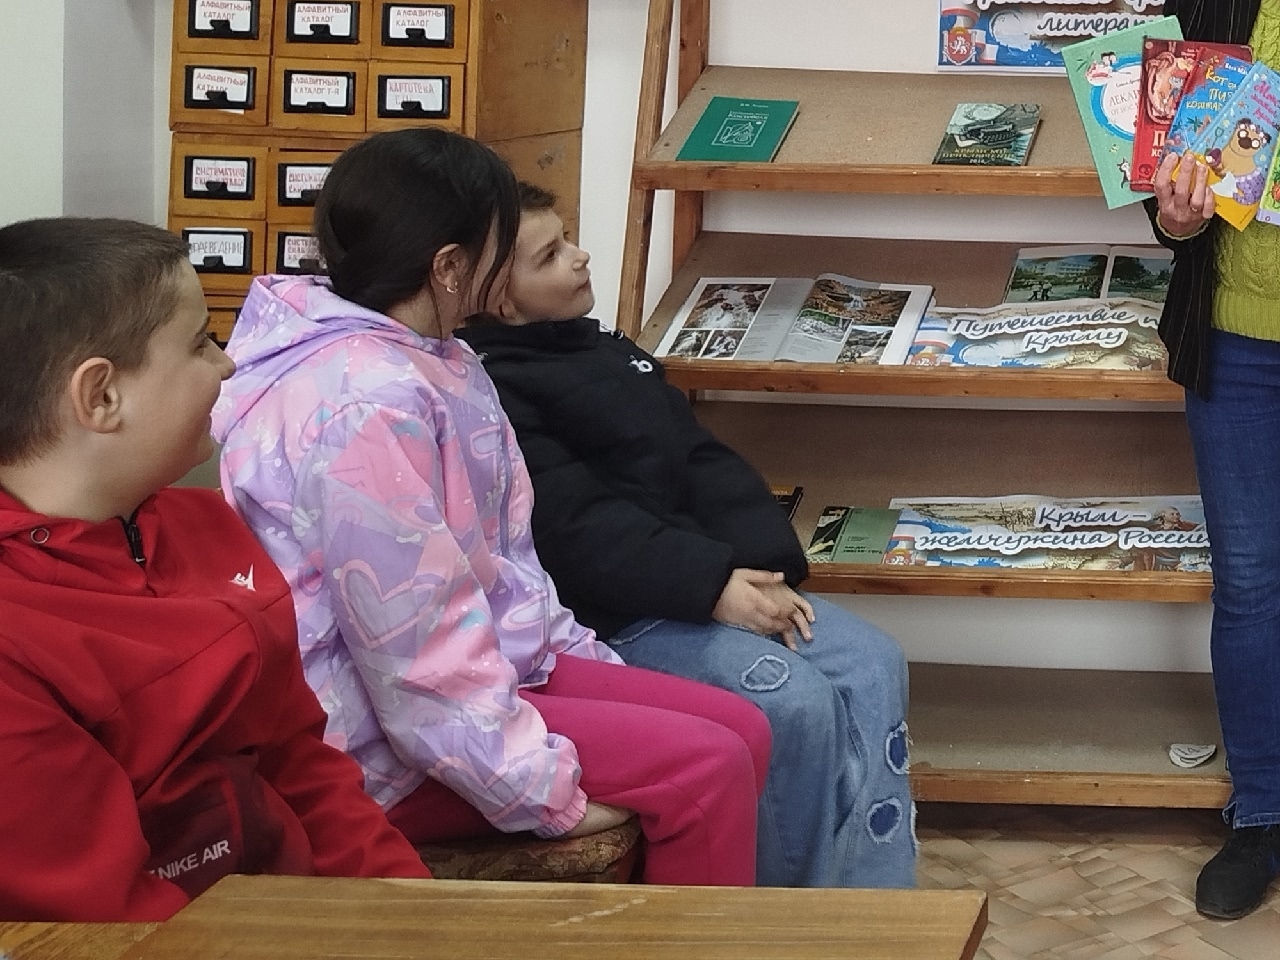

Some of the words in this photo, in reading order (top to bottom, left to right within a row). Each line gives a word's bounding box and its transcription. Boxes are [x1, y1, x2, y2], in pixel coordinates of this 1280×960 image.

[200, 0, 251, 13] АЛФАВИТНЫЙ
[297, 5, 349, 13] АЛФАВИТНЫЙ
[203, 11, 236, 20] КАТАЛОГ
[396, 9, 446, 18] АЛФАВИТНЫ
[395, 19, 430, 27] КАТАЛОГ
[196, 72, 247, 87] АЛФАВИТНЫЙ
[294, 86, 326, 95] КАТАЛОГ
[388, 81, 435, 94] КАРТОТЕКА
[951, 308, 1135, 336] Путешествие
[1024, 330, 1124, 349] Крыму
[1038, 508, 1129, 527] Крым
[919, 531, 1110, 553] жемчужина
[158, 853, 199, 880] NIKE
[202, 839, 231, 864] AIR
